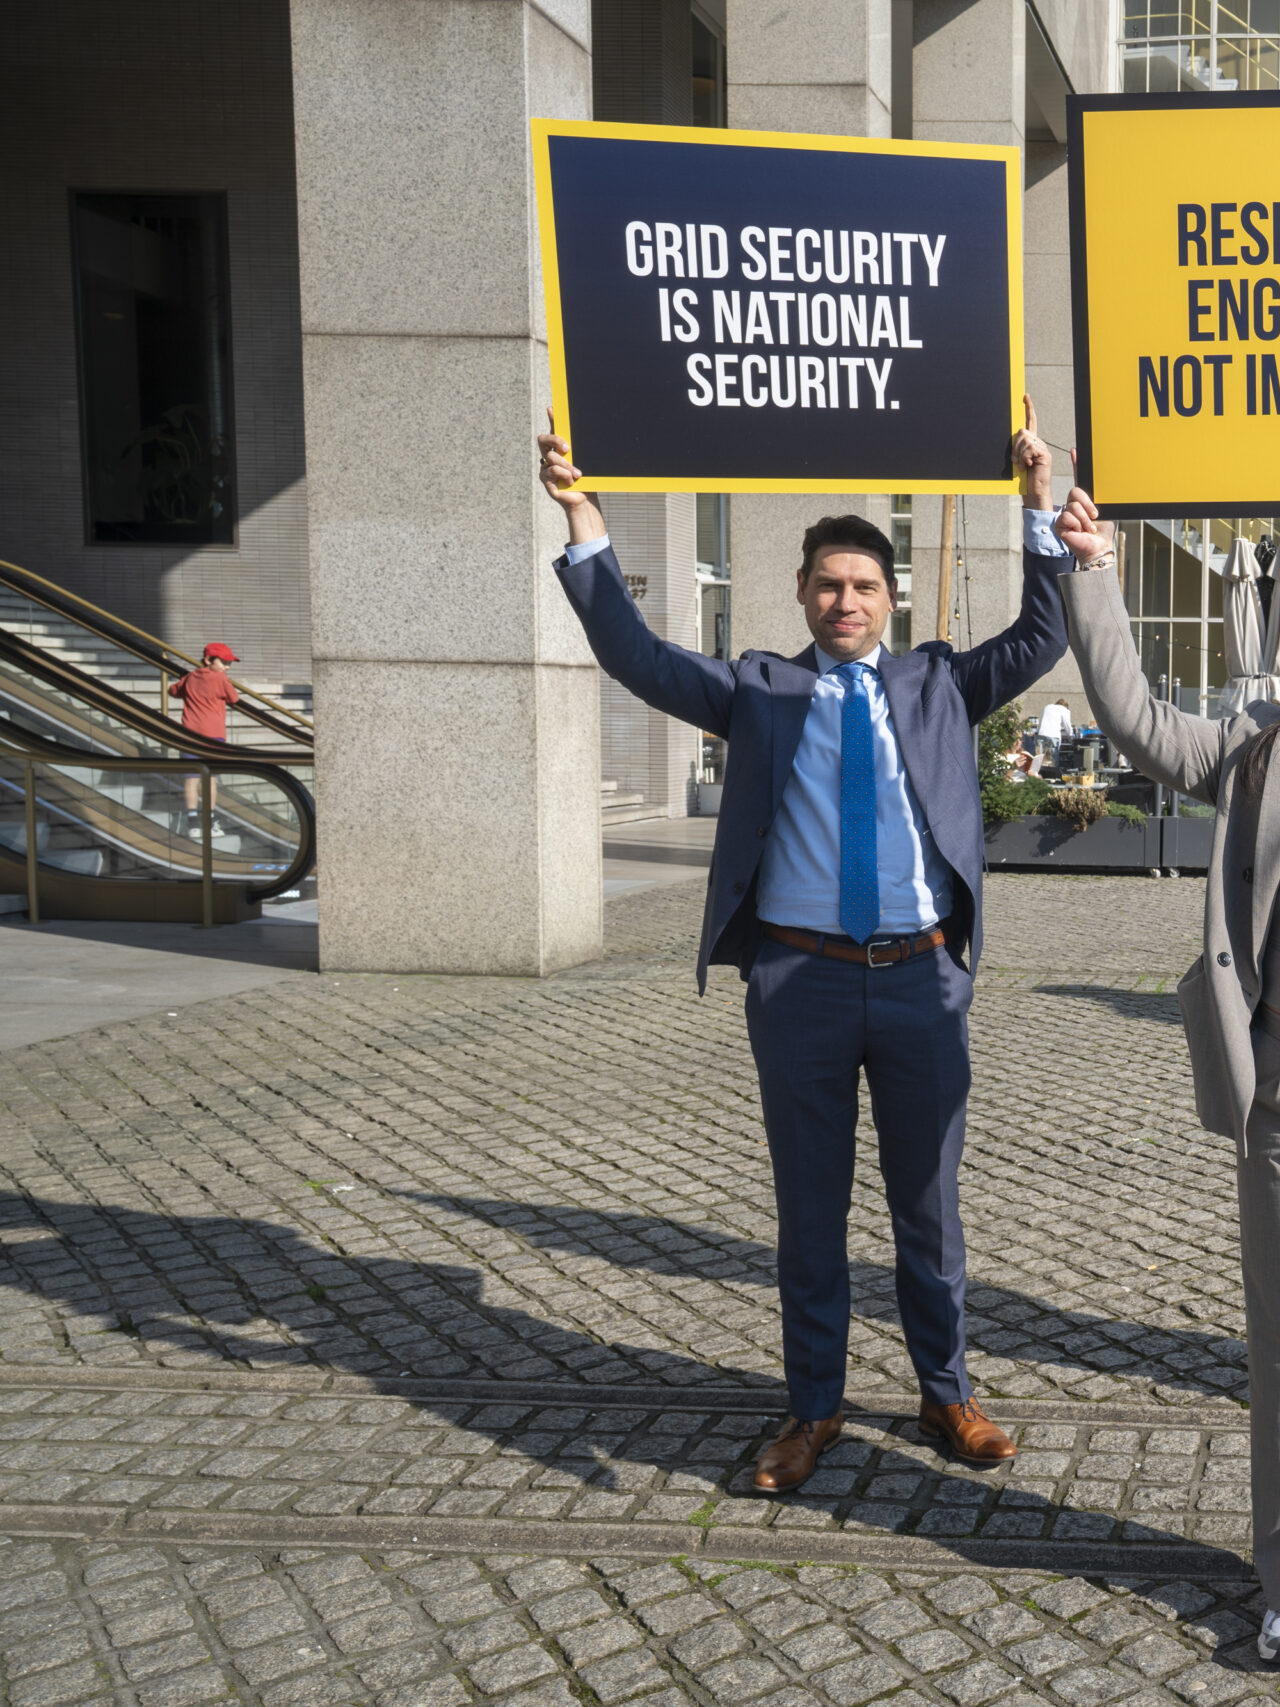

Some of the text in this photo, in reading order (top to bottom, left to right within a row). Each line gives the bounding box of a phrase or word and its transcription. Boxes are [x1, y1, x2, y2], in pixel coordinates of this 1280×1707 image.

[625, 220, 947, 287] GRID SECURITY
[658, 287, 924, 349] IS NATIONAL
[686, 352, 901, 410] SECURITY.
[1138, 354, 1233, 418] NOT
